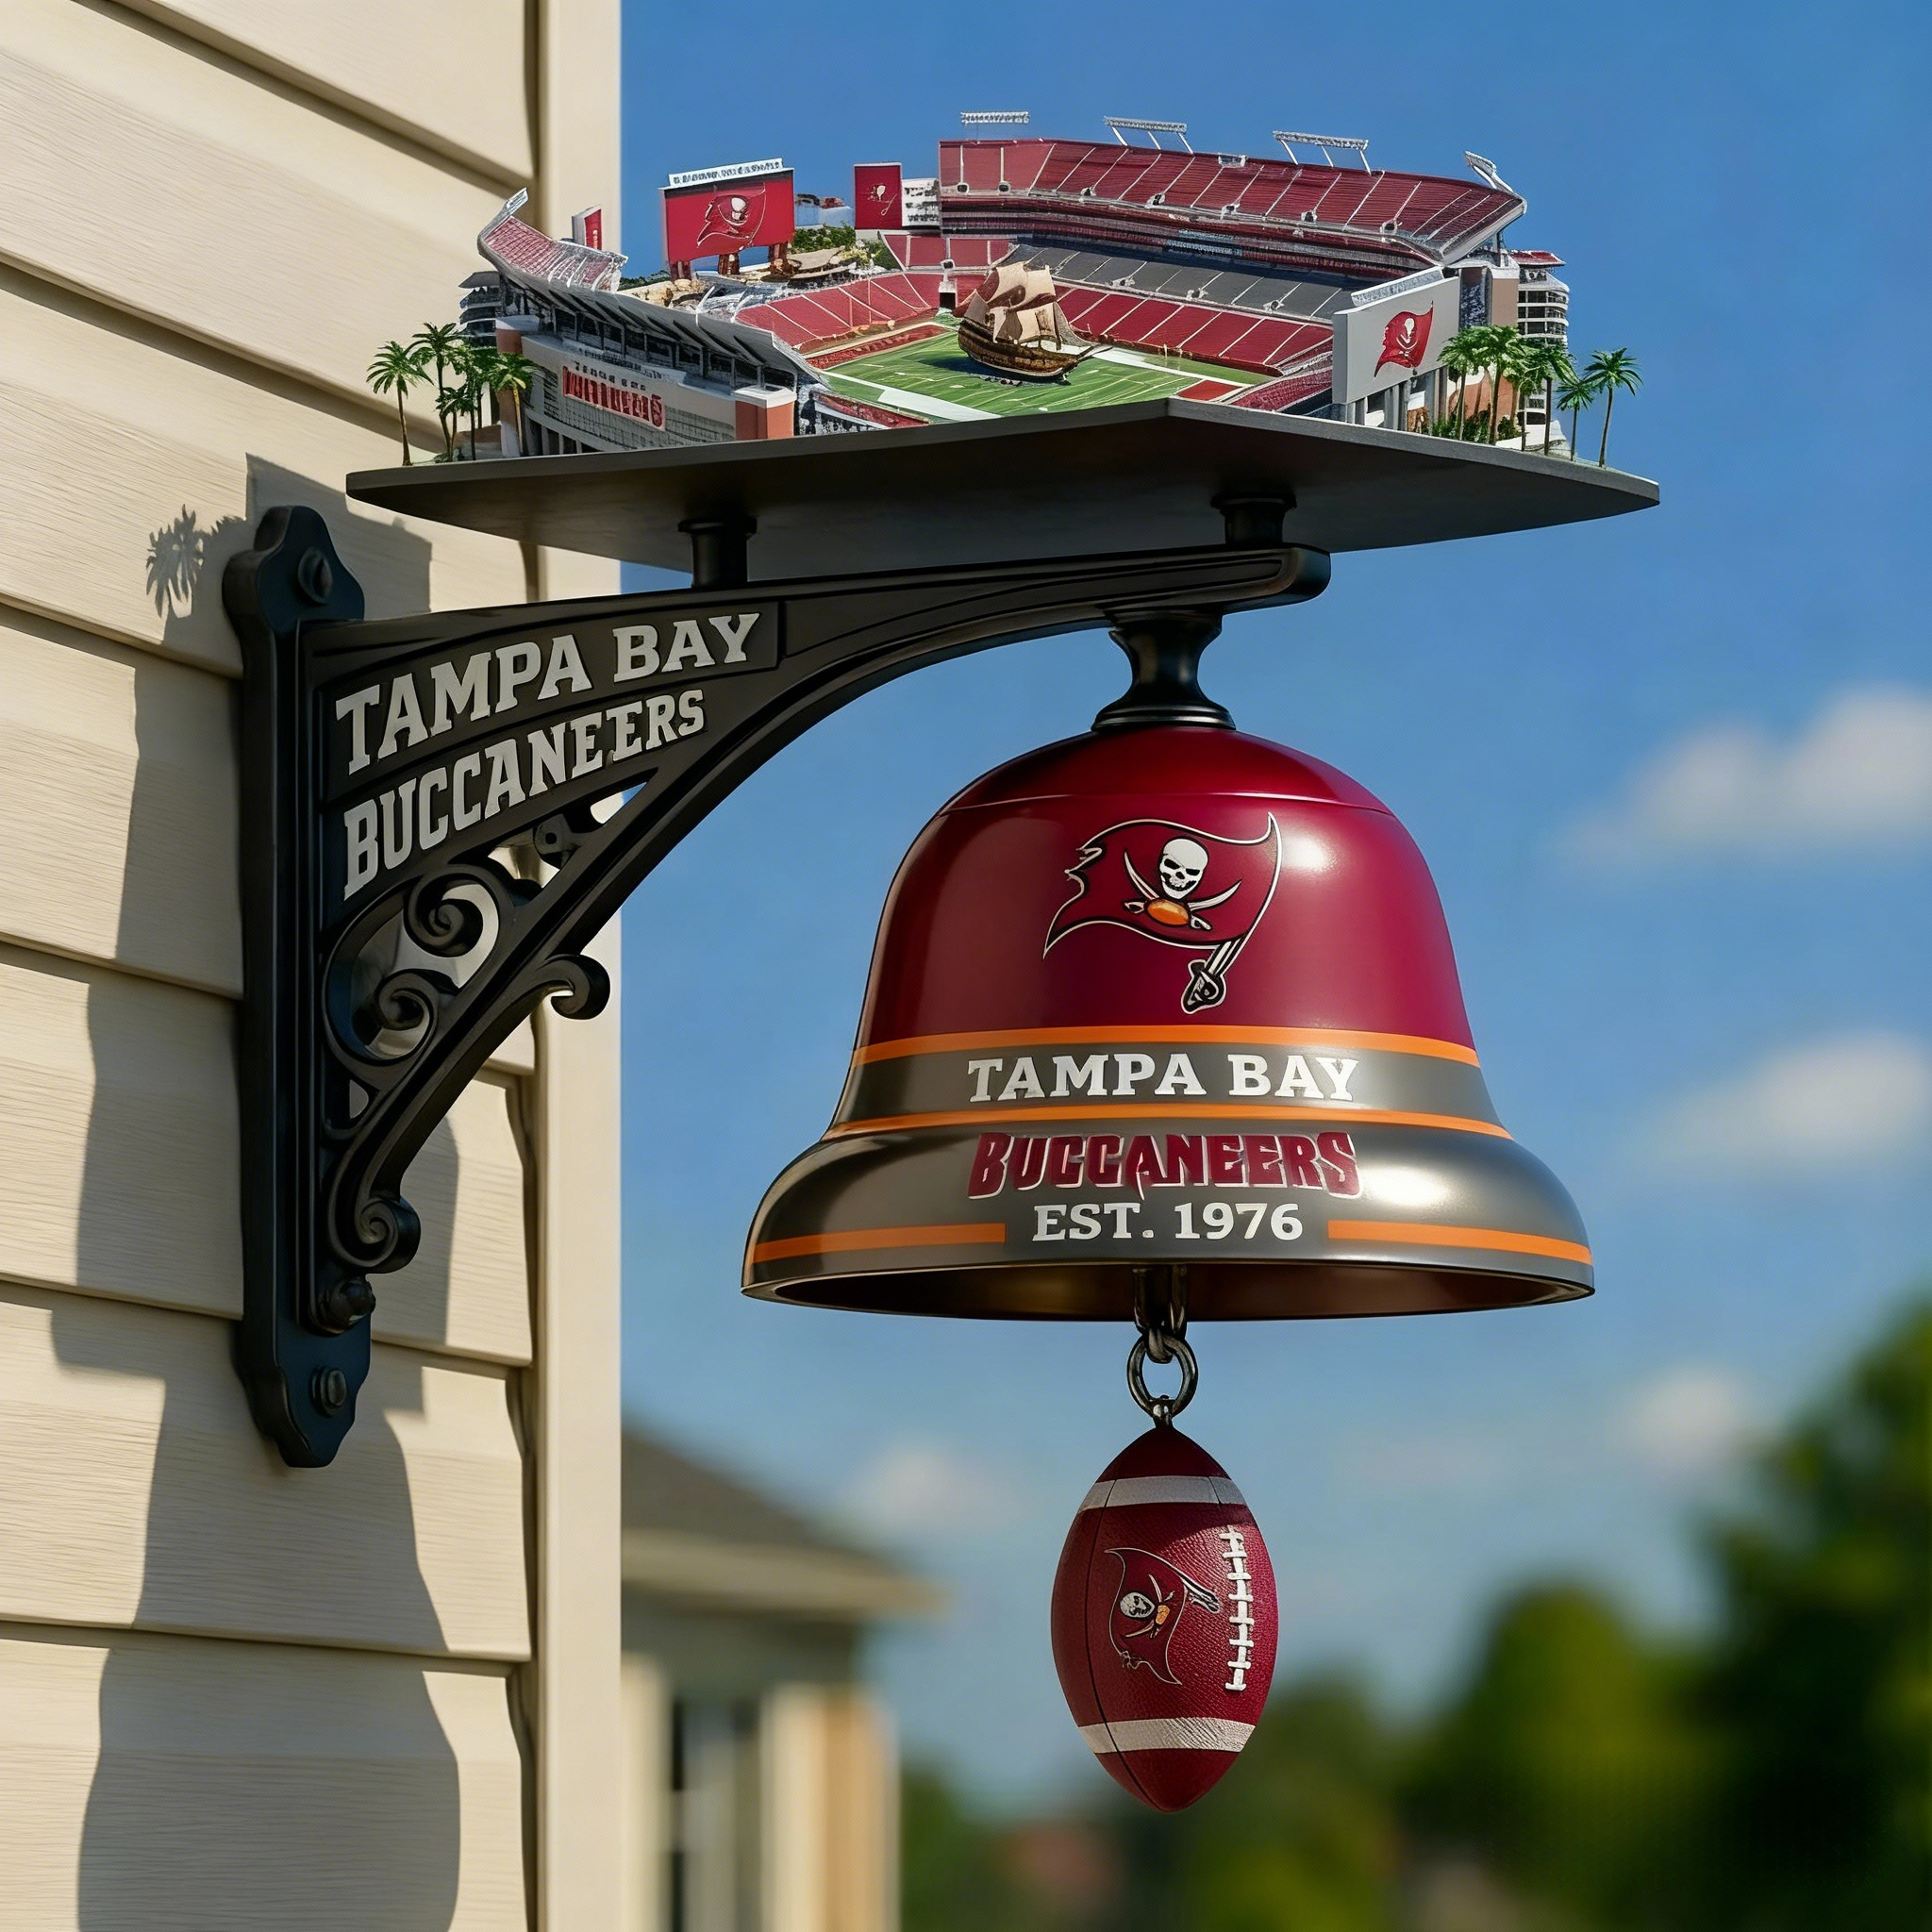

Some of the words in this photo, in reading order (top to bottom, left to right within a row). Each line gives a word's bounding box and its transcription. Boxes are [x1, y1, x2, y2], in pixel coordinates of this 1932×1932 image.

[335, 634, 593, 776] TAMPA
[612, 612, 760, 683] BAY
[343, 689, 704, 902] BUCCANEERS
[968, 1053, 1207, 1102] TAMPA
[1227, 1054, 1360, 1101] BAY
[967, 1132, 1363, 1200] BUCCANEERS
[1032, 1203, 1155, 1242] EST.
[1174, 1202, 1304, 1241] 1976
